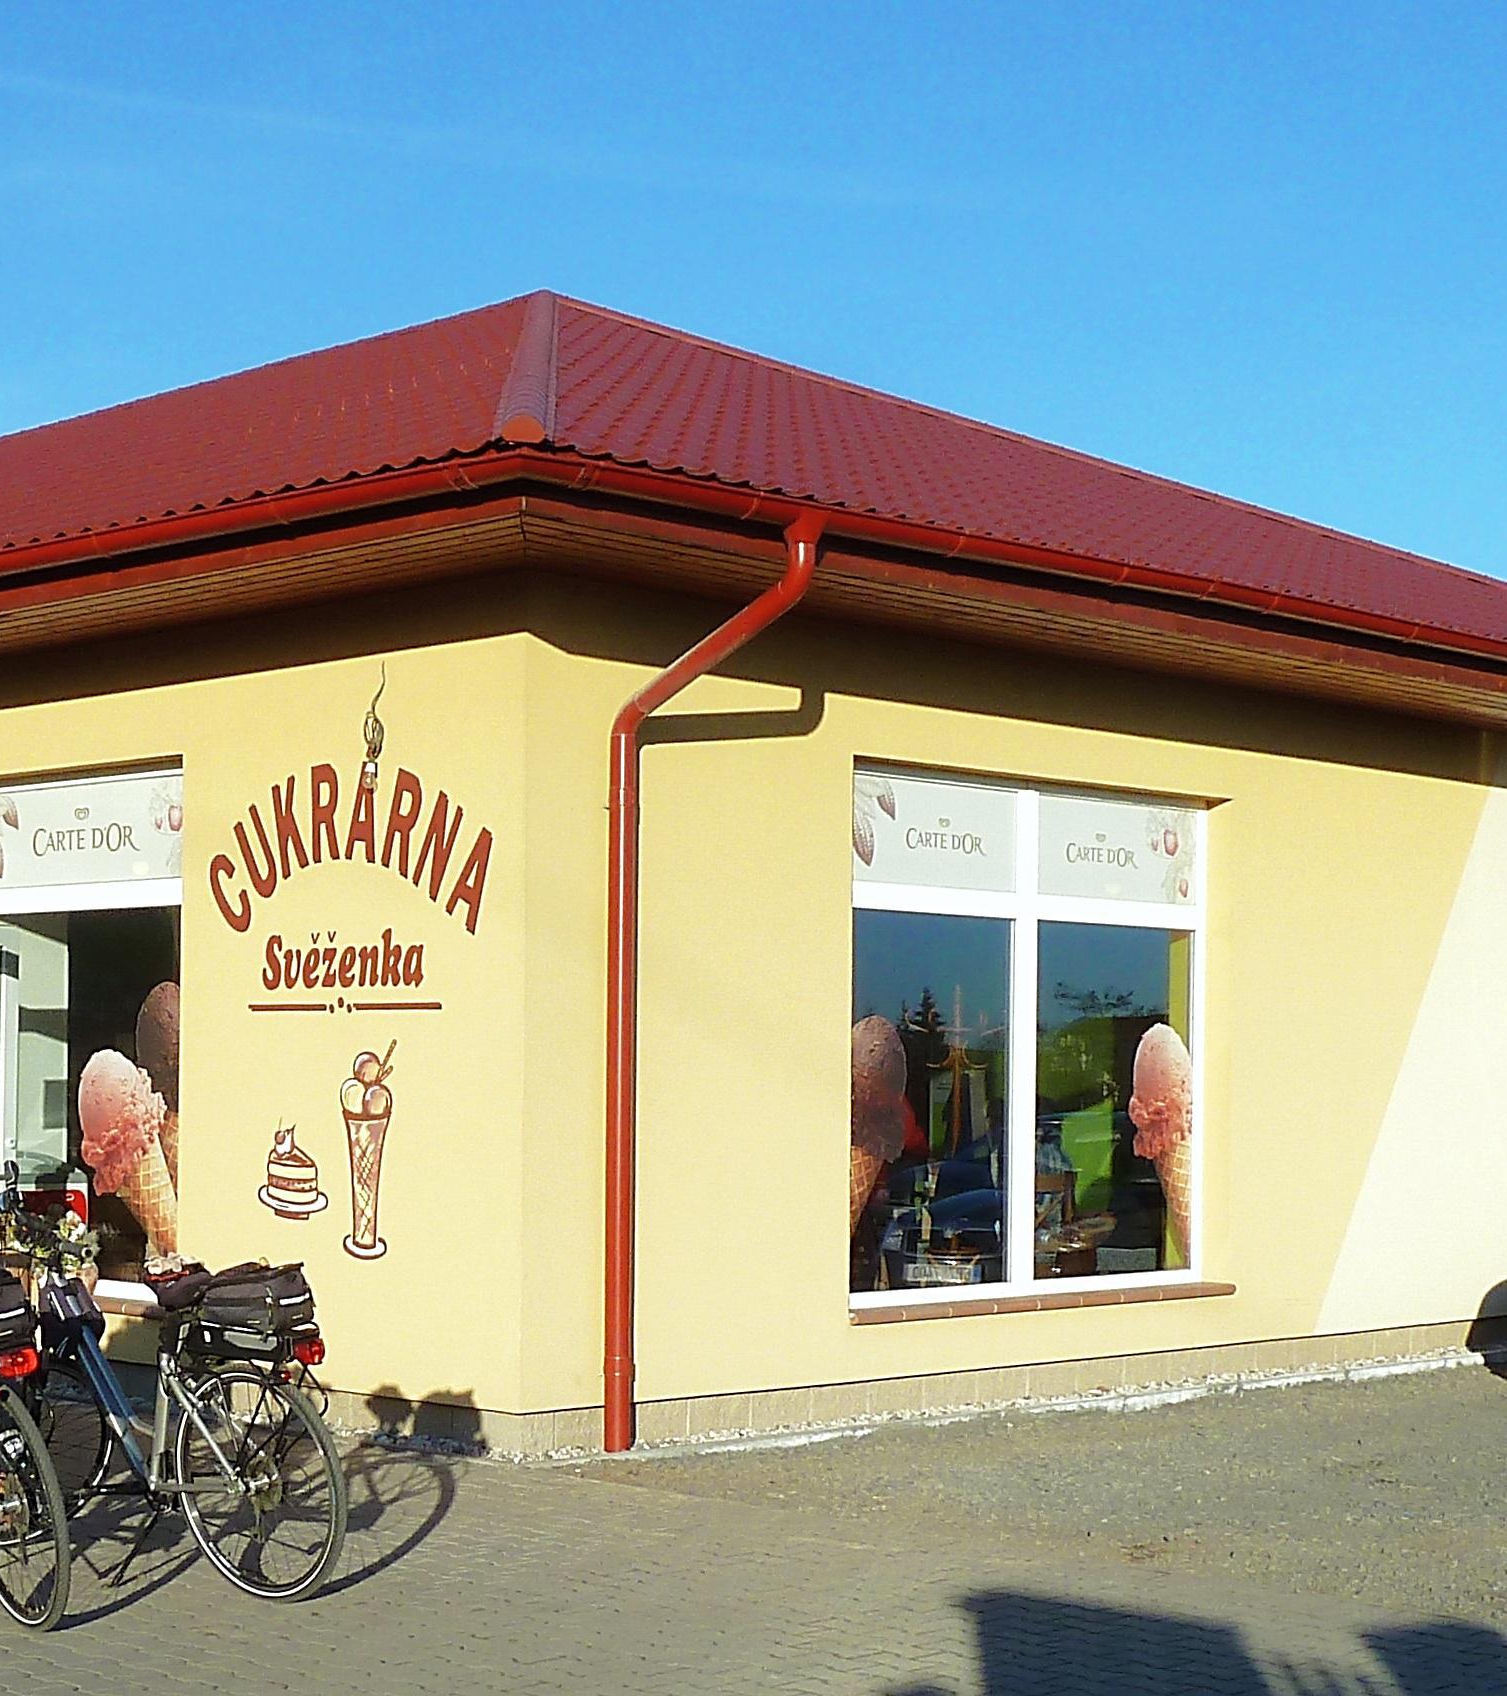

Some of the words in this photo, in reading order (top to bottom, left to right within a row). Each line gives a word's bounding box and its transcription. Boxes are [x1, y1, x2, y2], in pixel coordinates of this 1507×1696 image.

[33, 828, 87, 857] CARTE
[91, 822, 141, 852] D'OR
[906, 827, 948, 850] CARTE
[951, 833, 988, 857] D'OR
[1066, 842, 1104, 864] CARTE
[262, 928, 424, 991] Svěženka
